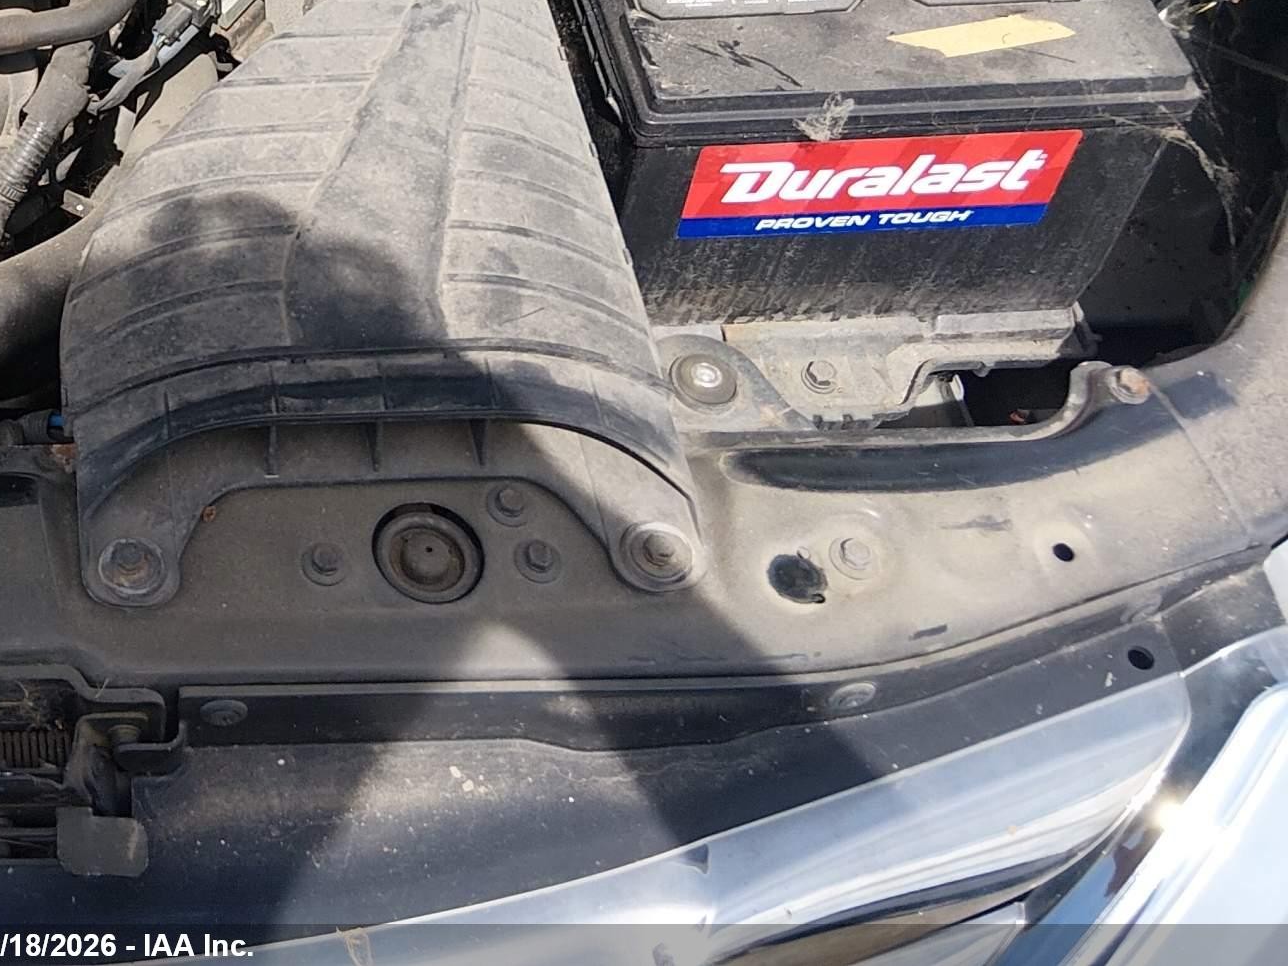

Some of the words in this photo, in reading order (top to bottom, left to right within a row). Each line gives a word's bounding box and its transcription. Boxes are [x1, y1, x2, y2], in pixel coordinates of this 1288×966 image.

[720, 149, 1044, 204] Duralast
[755, 215, 875, 232] PROVEN
[878, 210, 971, 226] TOUGH
